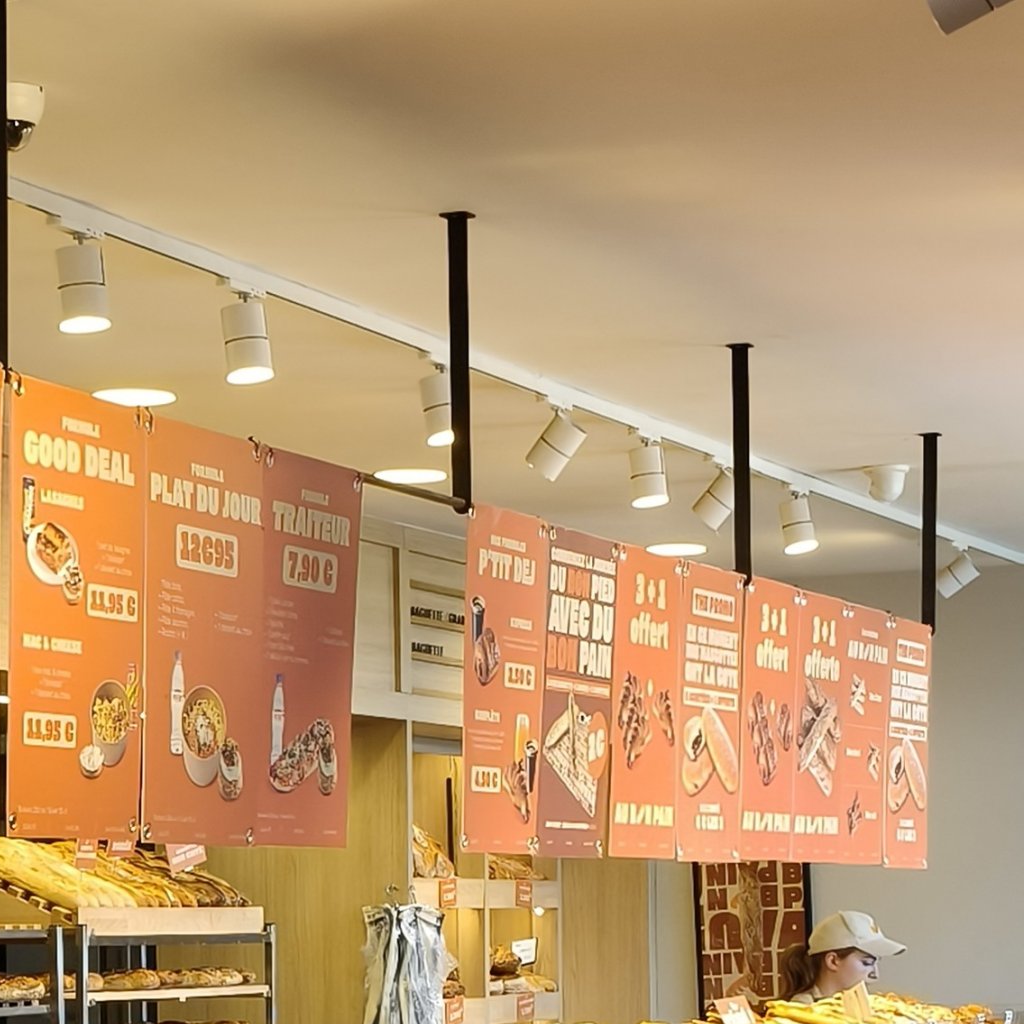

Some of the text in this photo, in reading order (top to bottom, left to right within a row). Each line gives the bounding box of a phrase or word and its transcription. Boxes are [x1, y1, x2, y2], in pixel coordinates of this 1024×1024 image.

[24, 429, 135, 486] GOOD DEAL
[150, 471, 262, 526] PLAT DU JOUR
[272, 500, 351, 547] TRAITEUR
[287, 551, 320, 584] 7,90
[550, 563, 567, 593] DU
[591, 573, 616, 604] PIED
[548, 593, 615, 644] AVEC DU
[579, 639, 613, 680] PAIN
